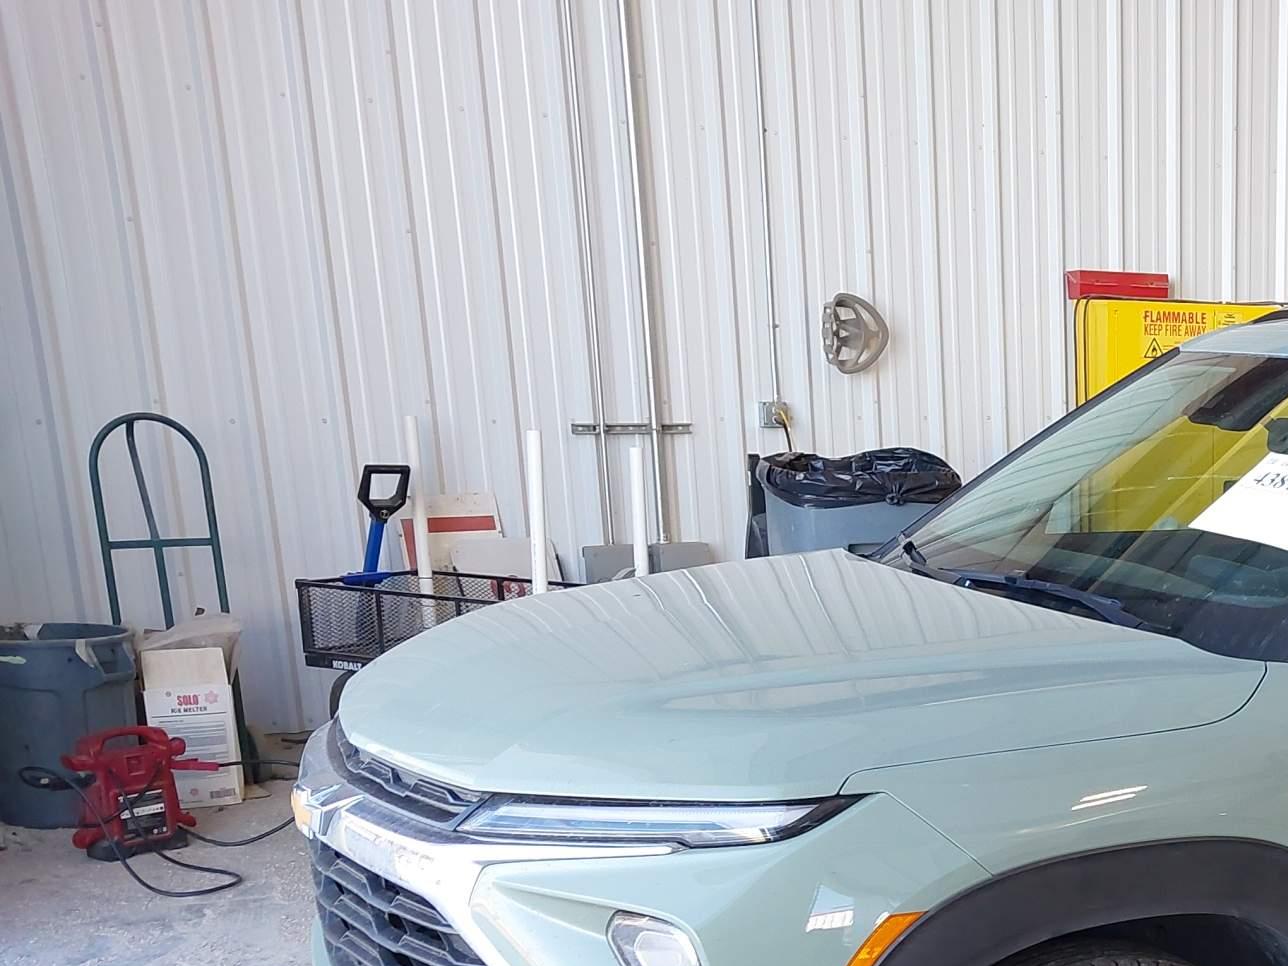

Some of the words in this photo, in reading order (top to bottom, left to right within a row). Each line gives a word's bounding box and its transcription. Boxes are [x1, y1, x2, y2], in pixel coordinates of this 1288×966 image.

[1144, 310, 1207, 325] FLAMMABLE
[1144, 323, 1163, 336] KEEP
[1165, 325, 1182, 337] FIRE
[1184, 325, 1207, 337] AWAY
[332, 660, 362, 671] KOBALT
[176, 694, 199, 706] SOLO
